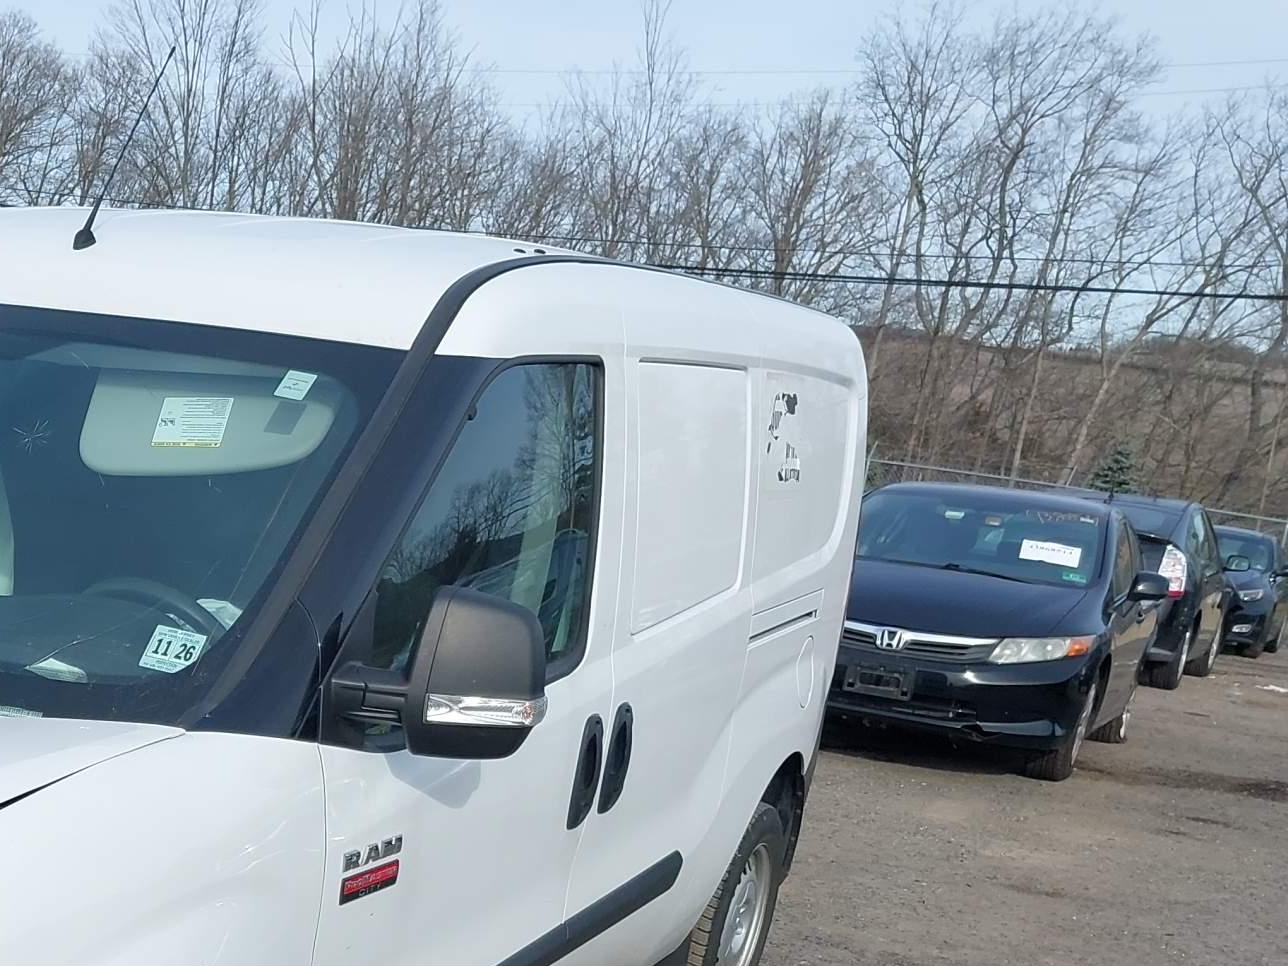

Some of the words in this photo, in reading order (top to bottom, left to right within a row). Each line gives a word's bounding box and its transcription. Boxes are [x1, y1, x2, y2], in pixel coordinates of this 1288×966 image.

[152, 638, 172, 657] 11
[173, 643, 196, 662] 26
[342, 833, 403, 873] RAM
